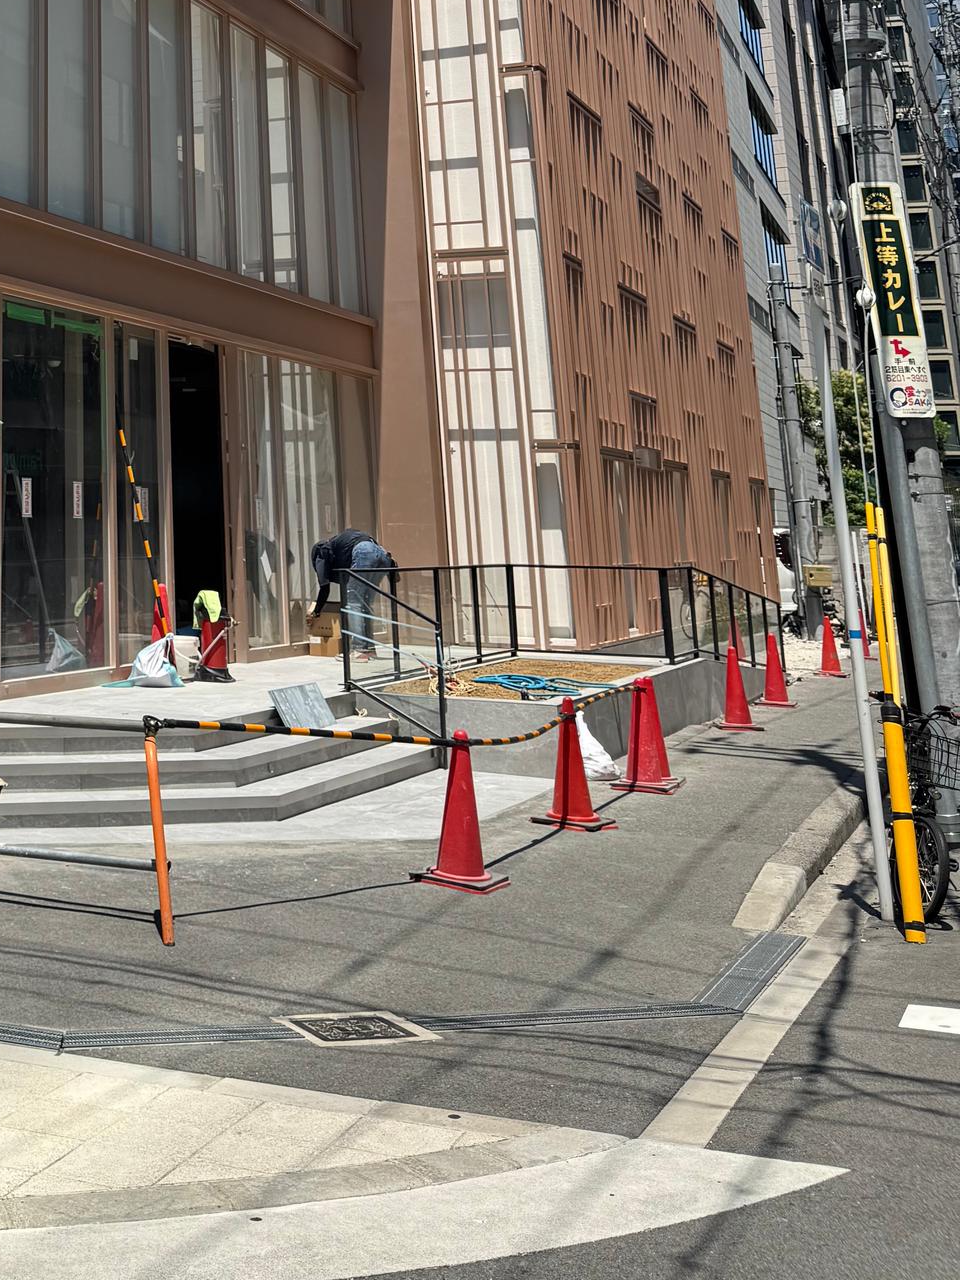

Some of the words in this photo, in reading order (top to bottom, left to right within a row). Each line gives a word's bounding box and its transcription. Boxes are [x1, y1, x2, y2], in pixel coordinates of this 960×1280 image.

[875, 222, 906, 332] 上等カレー
